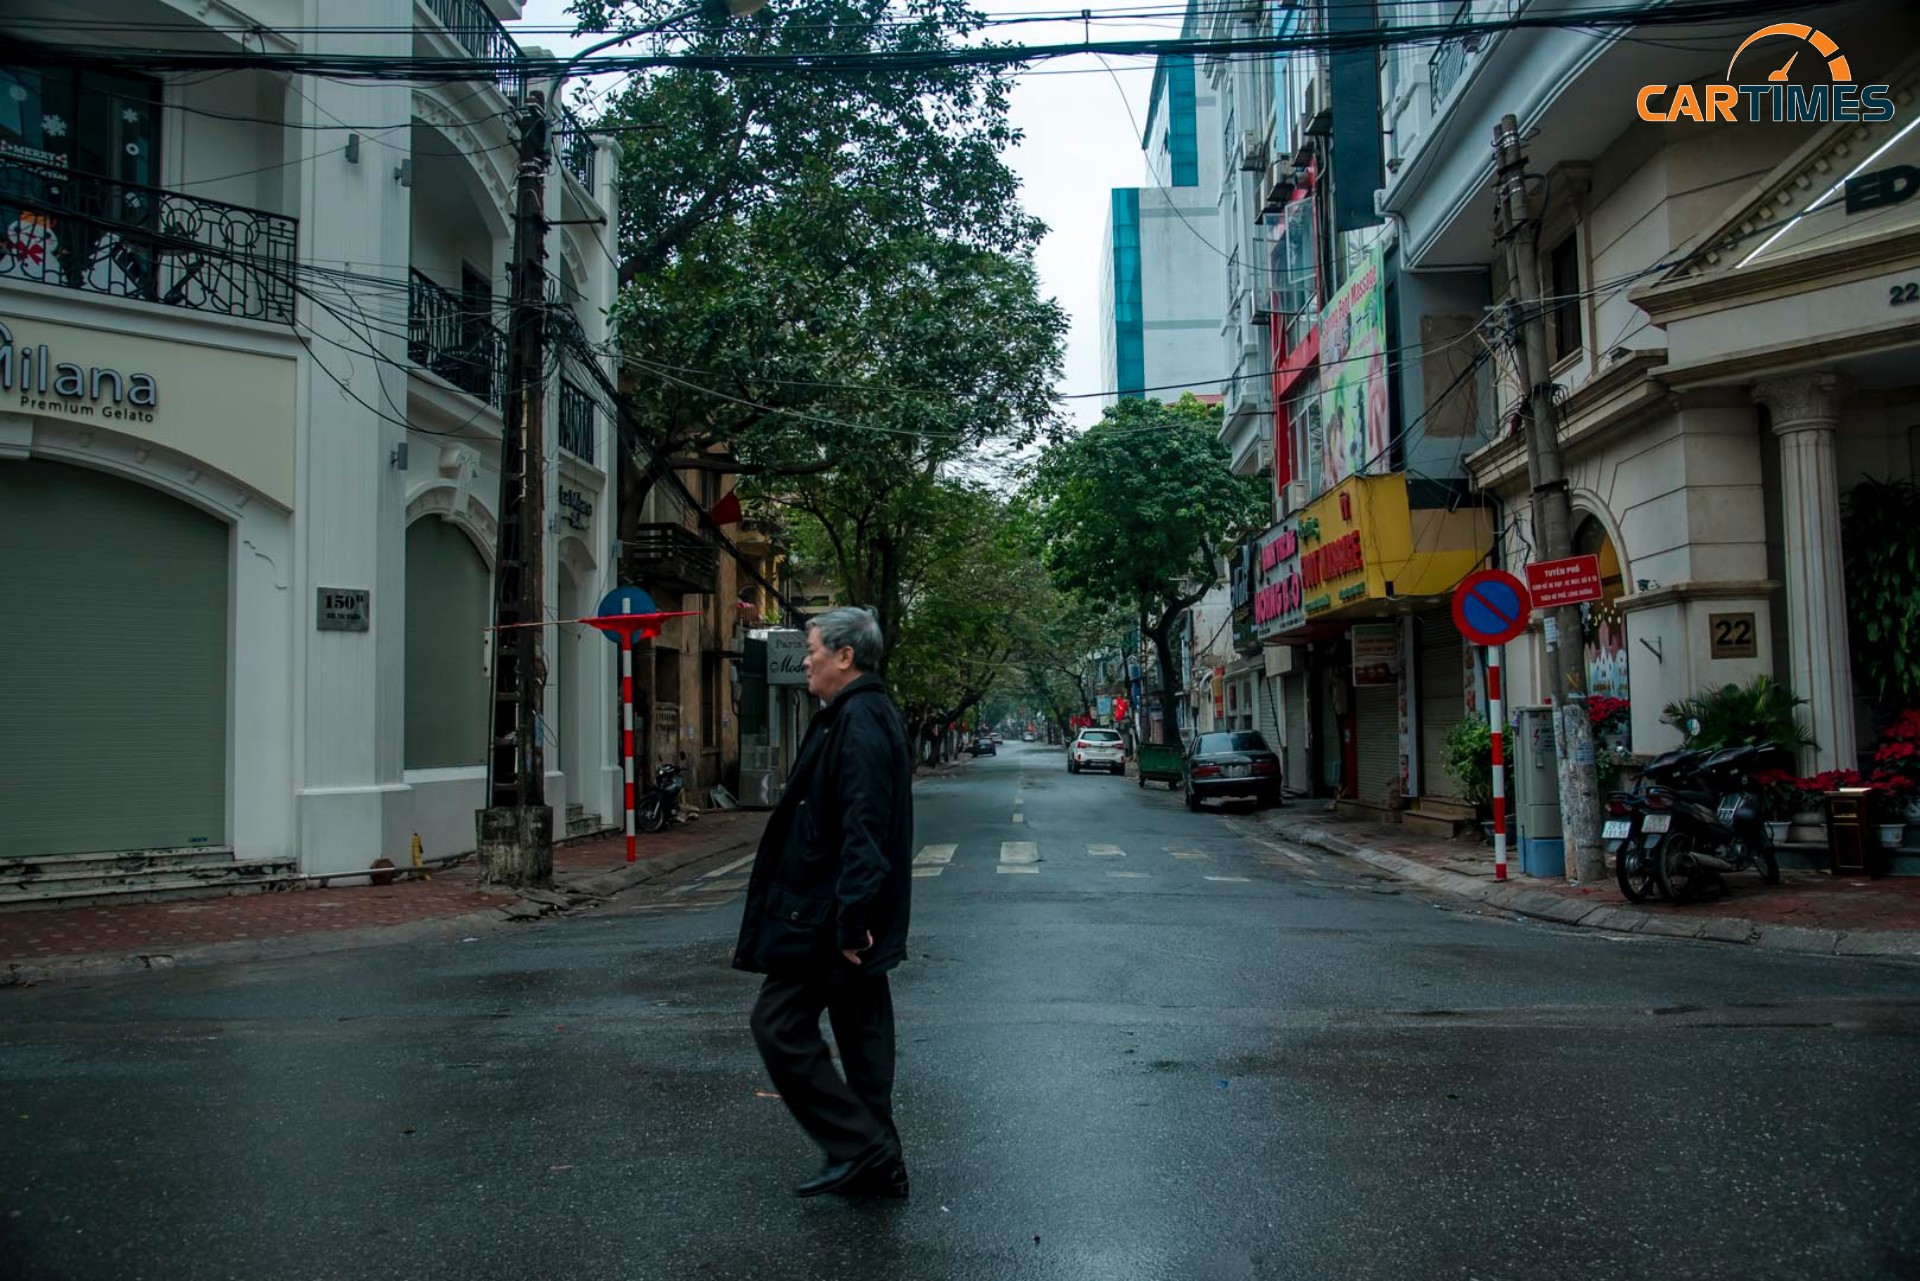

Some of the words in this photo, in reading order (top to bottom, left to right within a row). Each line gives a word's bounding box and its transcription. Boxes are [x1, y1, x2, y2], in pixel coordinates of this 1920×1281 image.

[1889, 282, 1919, 305] 22
[20, 395, 94, 417] Premium
[102, 405, 154, 423] Gelato
[776, 639, 802, 649] Paris
[1715, 620, 1752, 645] 22
